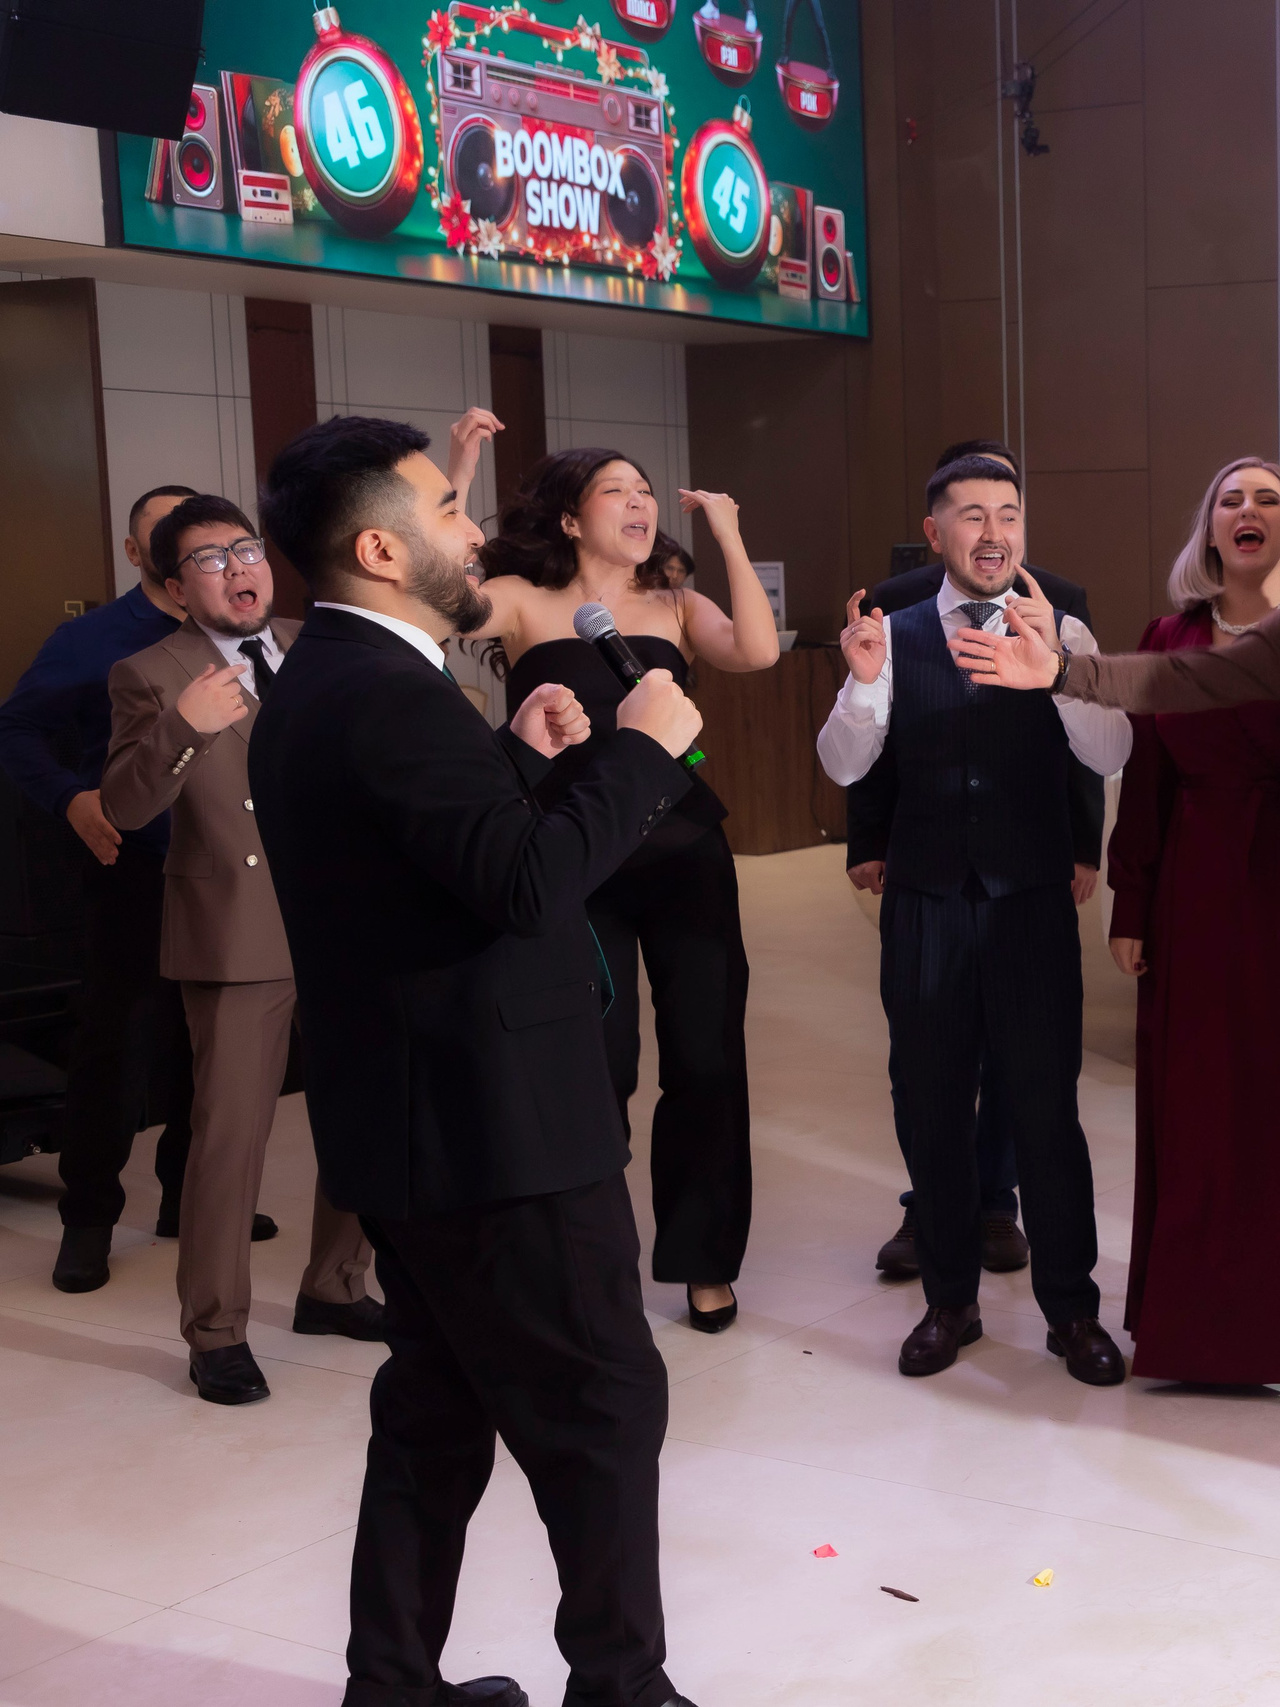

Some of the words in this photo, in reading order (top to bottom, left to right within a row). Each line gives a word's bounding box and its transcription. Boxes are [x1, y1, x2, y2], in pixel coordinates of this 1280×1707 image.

[322, 79, 387, 169] 46
[494, 128, 627, 200] BOOMBOX
[525, 178, 601, 235] SHOW
[711, 165, 750, 234] 45
